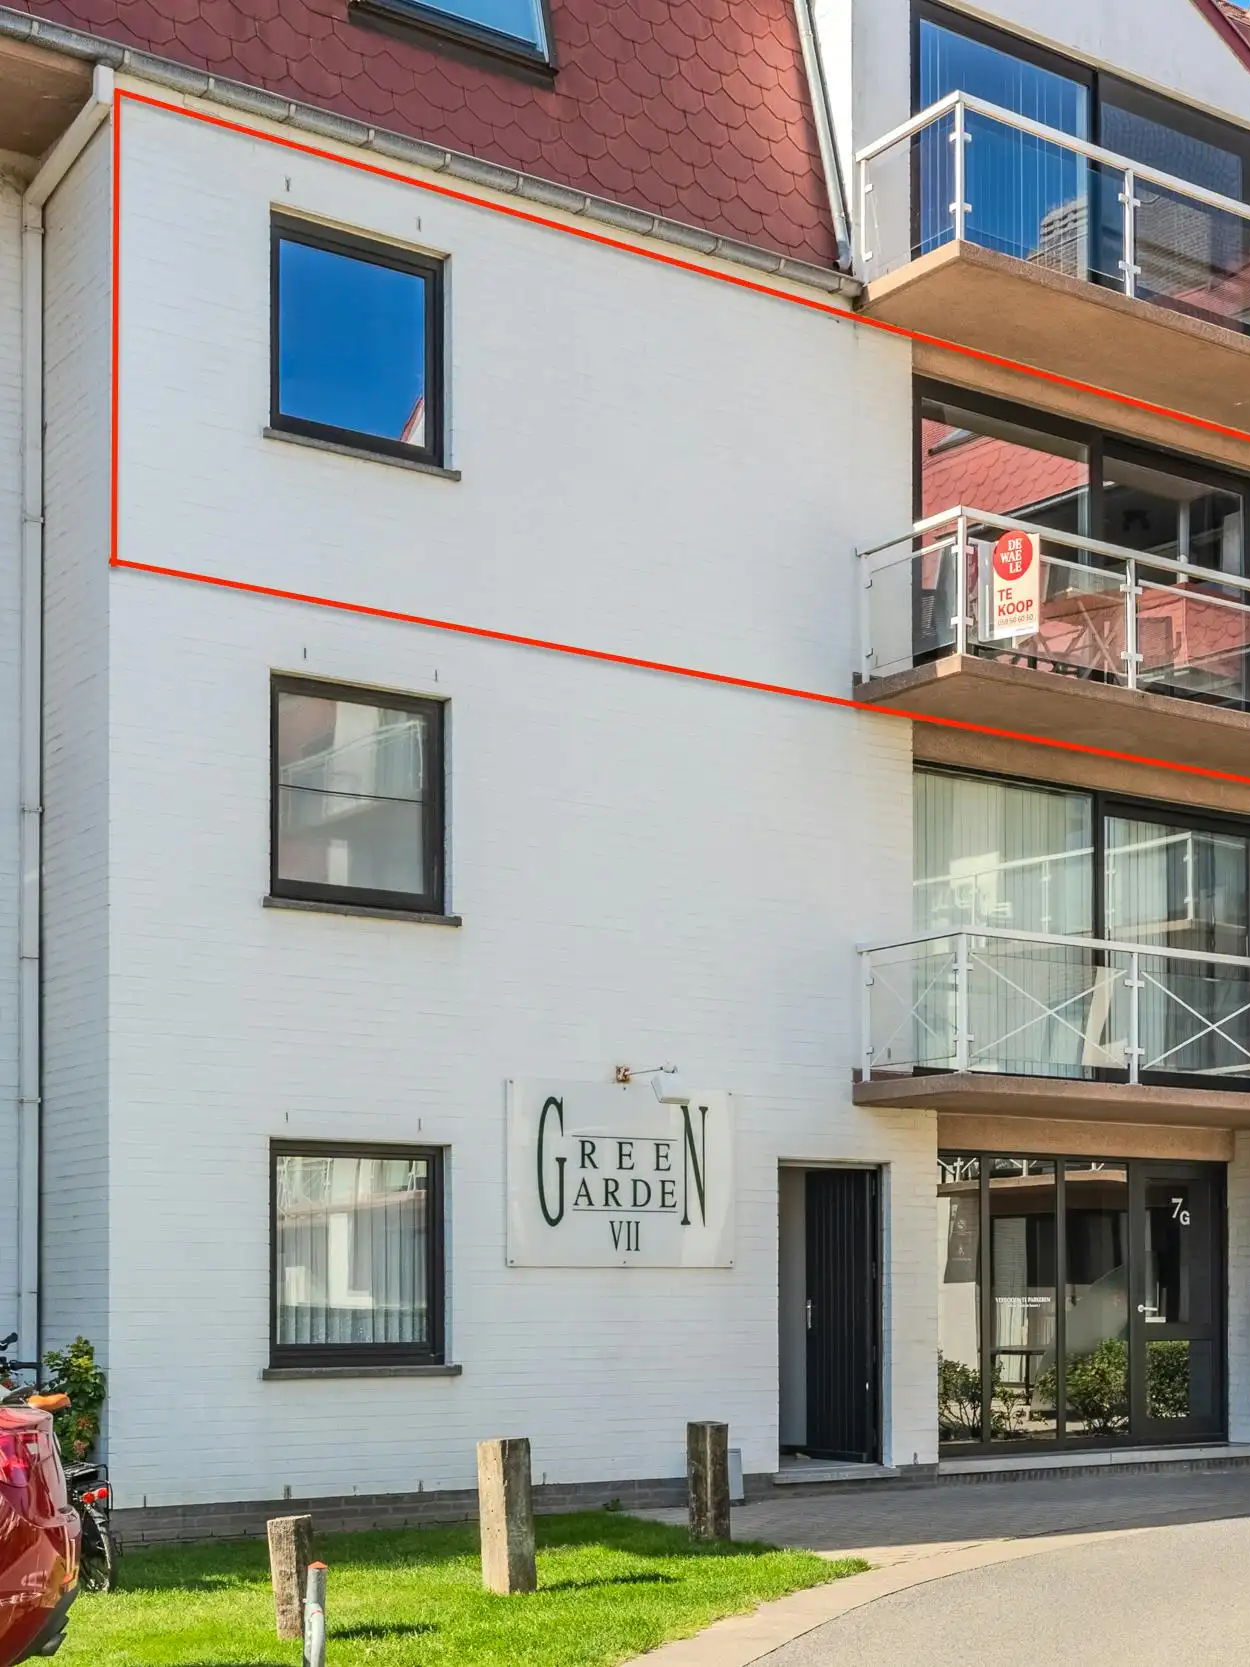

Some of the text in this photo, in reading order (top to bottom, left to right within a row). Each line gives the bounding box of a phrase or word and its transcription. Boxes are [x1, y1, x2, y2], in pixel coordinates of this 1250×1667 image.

[1007, 538, 1023, 551] DE
[1000, 550, 1022, 564] WAE
[1009, 561, 1022, 574] LE
[998, 588, 1013, 602] TE
[998, 600, 1033, 617] KOOP
[609, 1220, 641, 1252] VII
